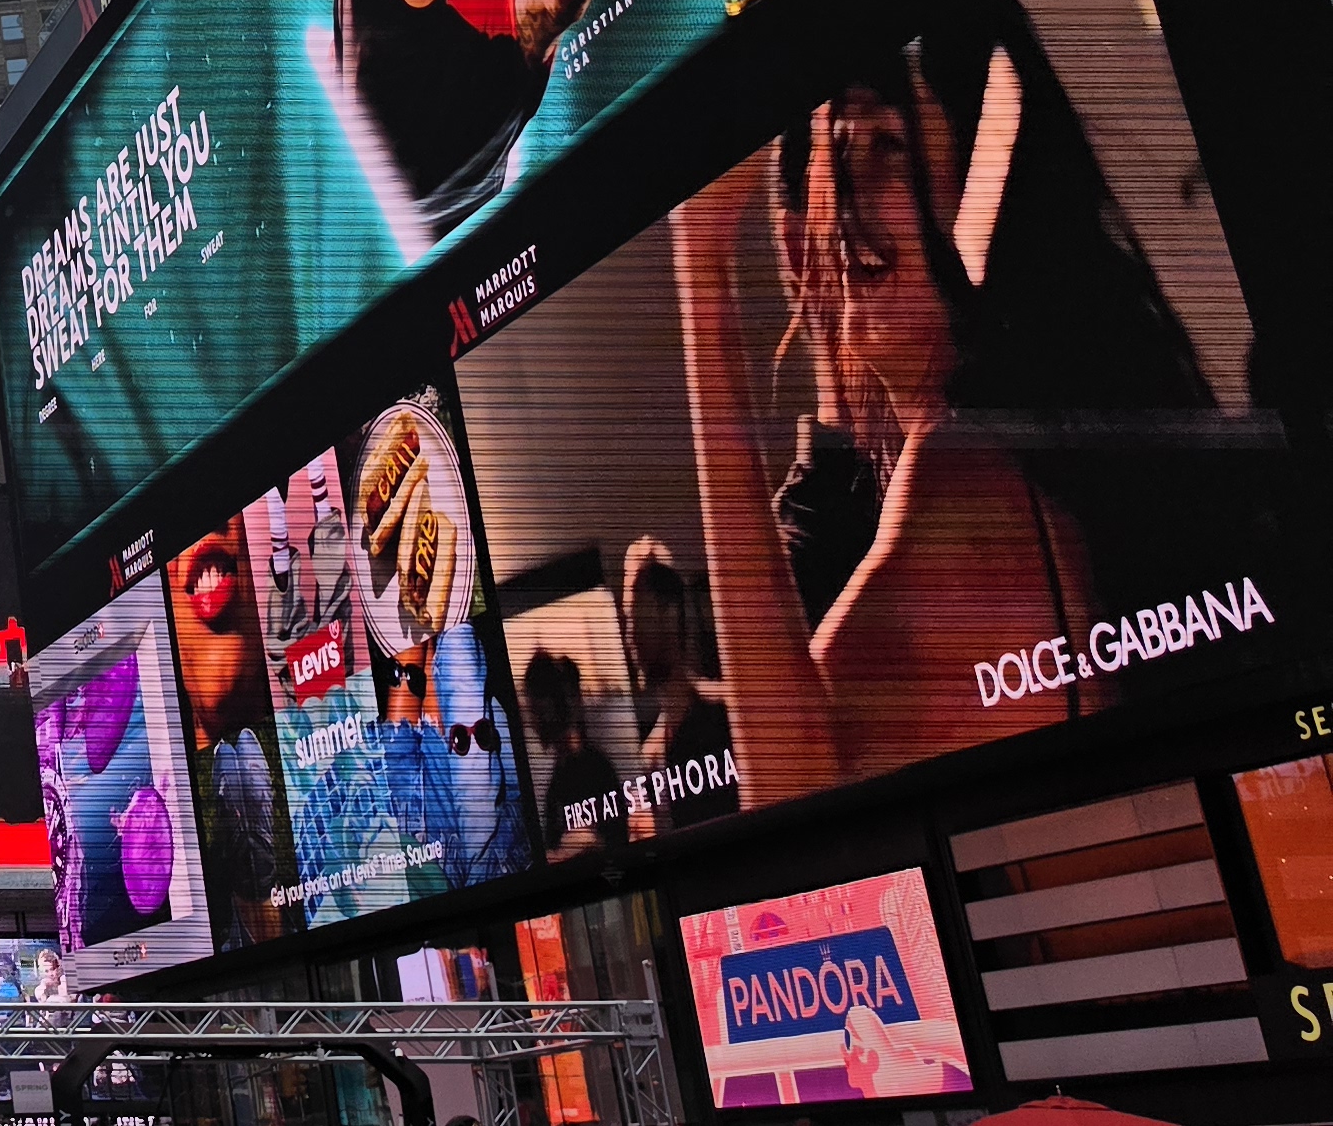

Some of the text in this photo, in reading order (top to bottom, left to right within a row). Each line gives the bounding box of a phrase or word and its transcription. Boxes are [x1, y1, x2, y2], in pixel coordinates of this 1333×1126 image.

[564, 51, 590, 80] USA
[21, 84, 182, 310] DREAMS ARE JUST
[25, 110, 211, 351] DREAMS UNTIL YOU
[31, 186, 198, 391] SWEAT FOR THEM
[143, 297, 158, 320] FOR
[200, 230, 224, 264] SWEAT
[475, 244, 536, 303] MARRIOTT
[480, 275, 535, 327] MARQUIS
[122, 529, 154, 562] MARRIOTT
[124, 550, 154, 580] MARQUIS
[294, 711, 366, 769] summer
[1294, 704, 1333, 740] SE
[563, 748, 740, 831] FIRST AT SEPHORA
[286, 881, 305, 907] your
[329, 872, 342, 891] on
[341, 867, 353, 887] at
[378, 850, 408, 873] Times
[407, 840, 444, 869] Square
[728, 955, 903, 1027] PANDORA
[15, 1083, 49, 1093] SPRING
